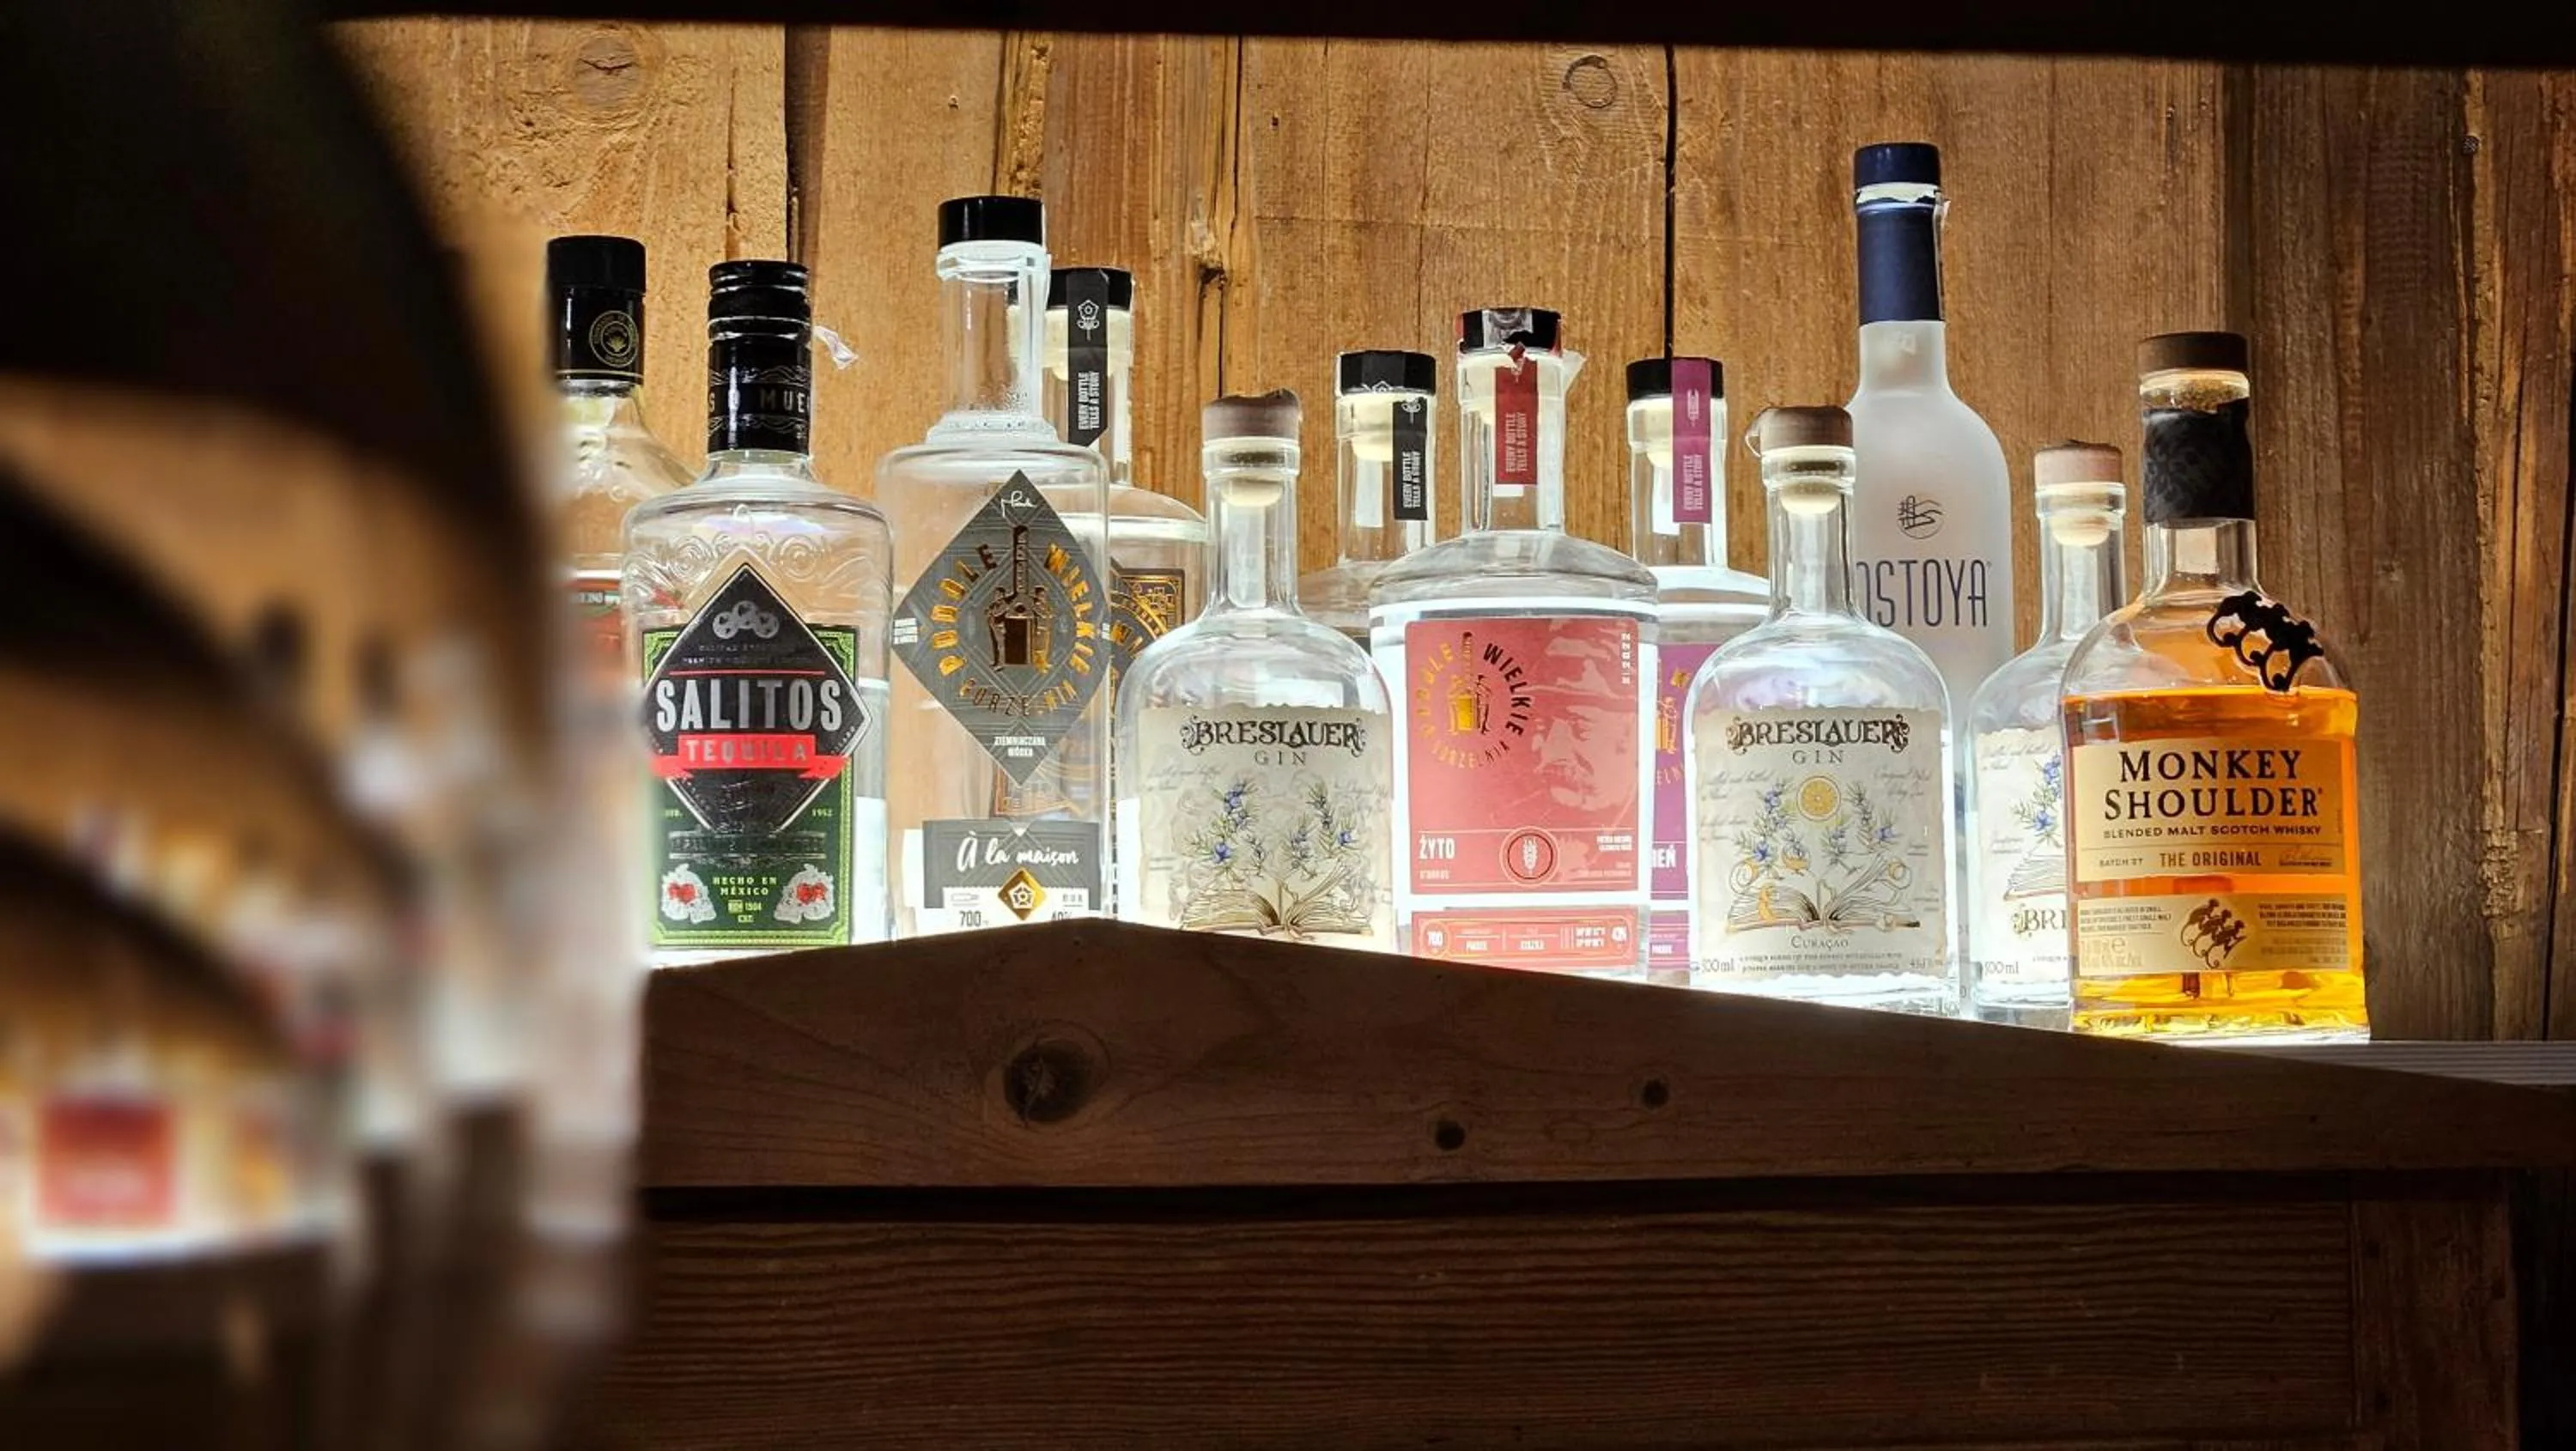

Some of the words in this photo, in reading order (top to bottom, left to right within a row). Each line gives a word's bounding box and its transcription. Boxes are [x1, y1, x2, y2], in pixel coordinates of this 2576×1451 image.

[1078, 373, 1089, 402] BOTTLE
[760, 388, 810, 413] MUE
[1483, 642, 1531, 736] WIELKIE
[656, 678, 842, 732] SALITOS
[1182, 715, 1365, 757] BRESLAUER
[1726, 714, 1909, 755] BRESLAUER
[687, 739, 807, 762] TEQUILA
[1254, 750, 1307, 766] GIN
[1792, 750, 1844, 764] GIN
[2119, 750, 2301, 782] MONKEY
[2105, 787, 2318, 820] SHOULDER
[2104, 827, 2162, 839] BLENDED
[2167, 826, 2205, 836] MALT
[2210, 825, 2269, 835] SCOTCH
[2274, 825, 2322, 835] WHISKY
[985, 837, 1008, 865] la
[1016, 847, 1079, 867] maison
[1419, 834, 1455, 859] ŻYTO
[2160, 853, 2185, 868] THE
[2192, 851, 2262, 867] ORIGINAL
[713, 877, 755, 885] HECHO
[762, 877, 777, 885] EN
[720, 886, 769, 895] MÉXICO
[959, 909, 982, 927] 700
